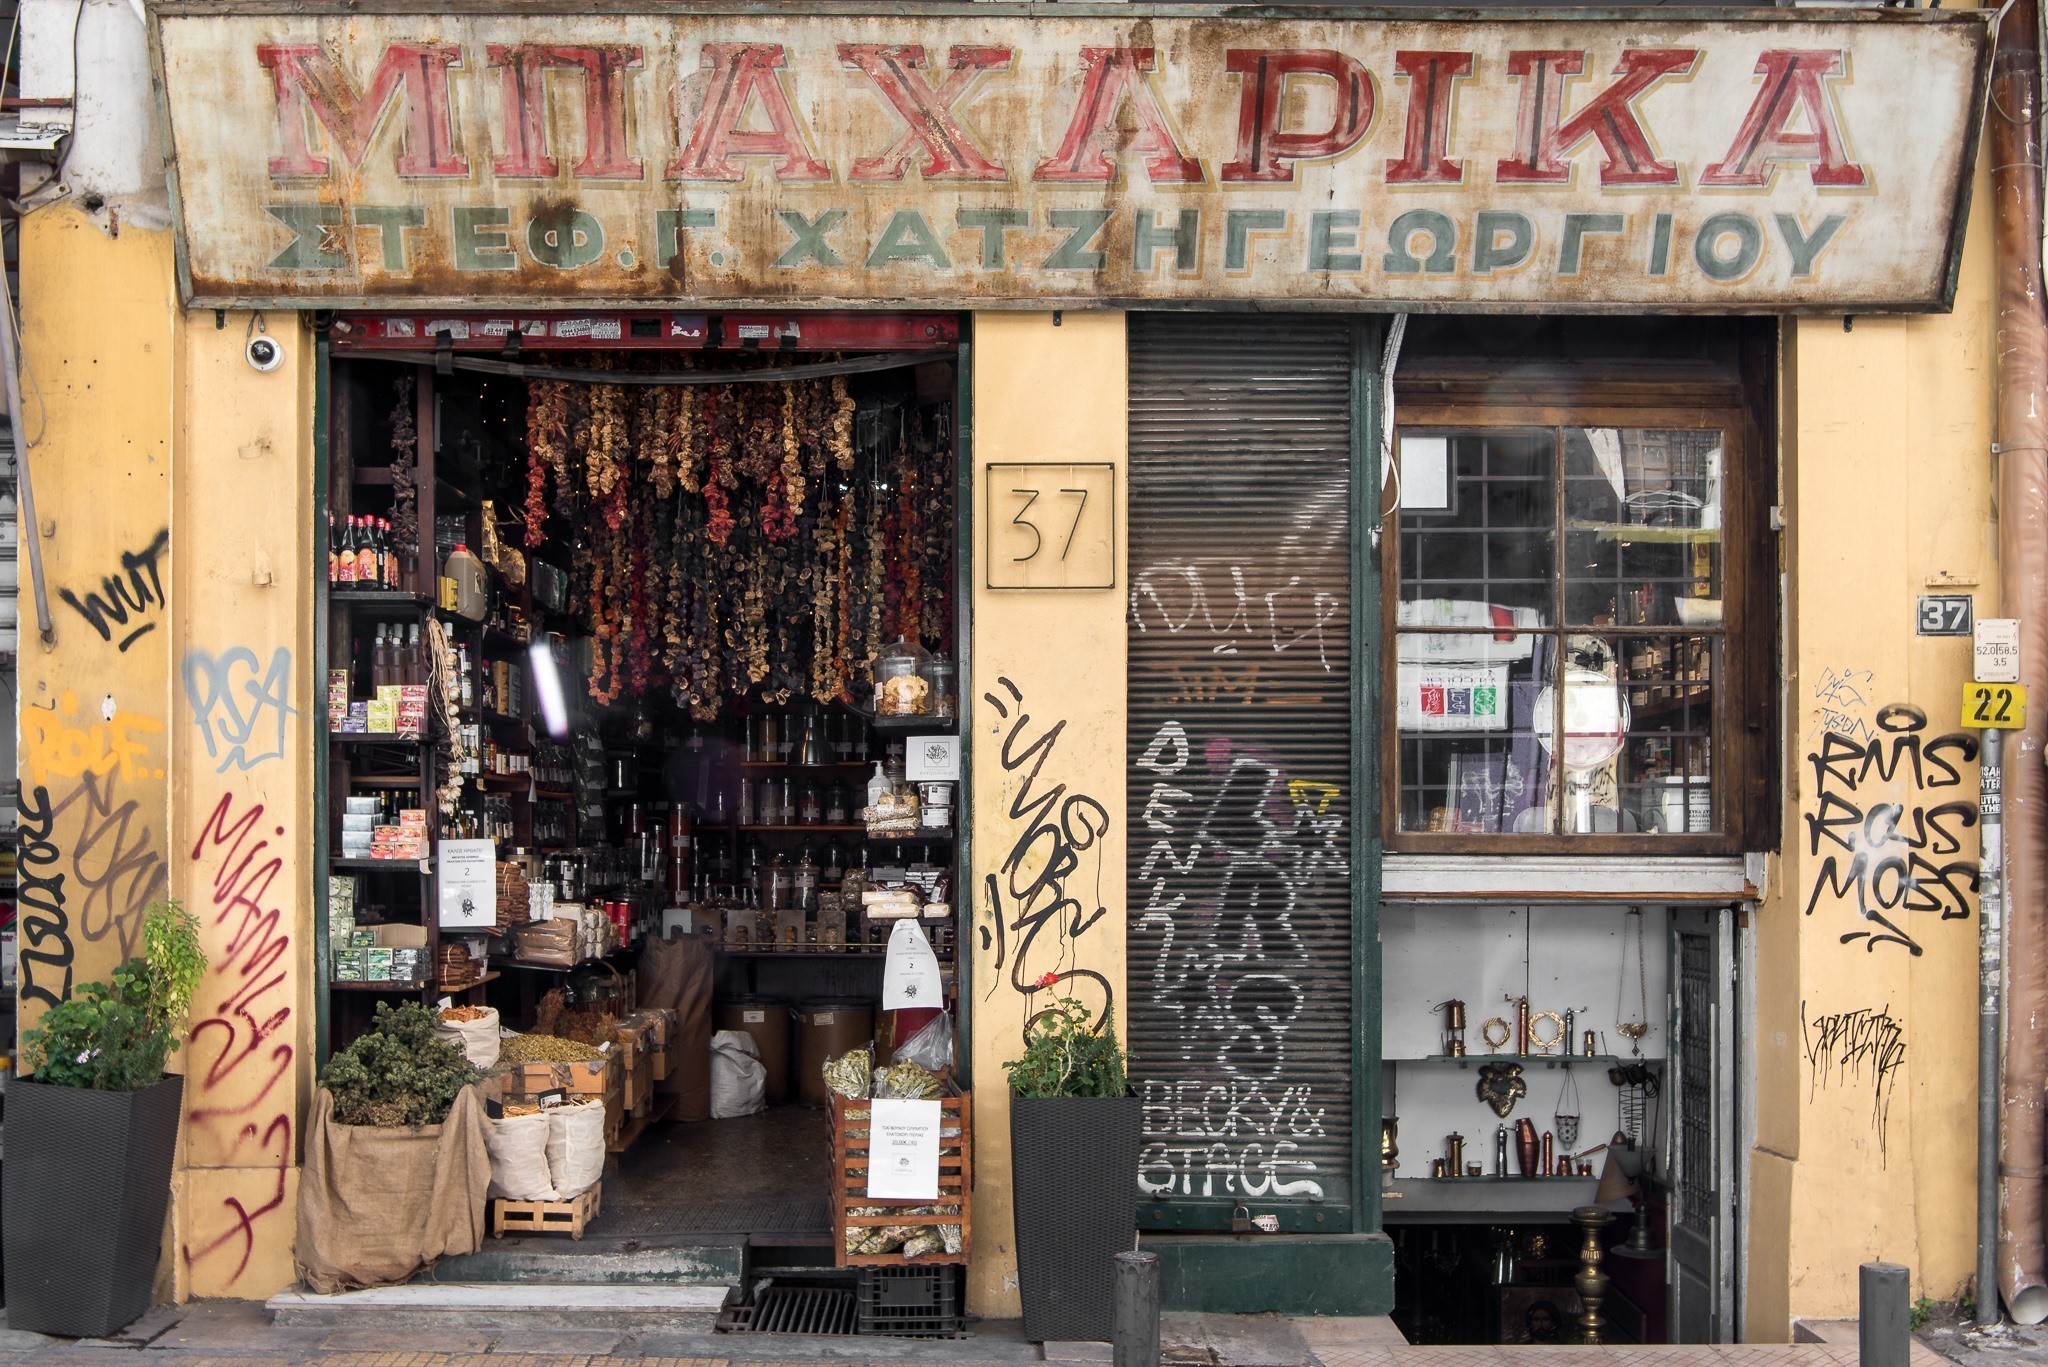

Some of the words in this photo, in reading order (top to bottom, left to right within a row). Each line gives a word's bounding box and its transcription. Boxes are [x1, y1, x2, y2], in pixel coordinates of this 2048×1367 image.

[257, 42, 1869, 187] ΜΠΑΧΑΡΙΚΑ
[266, 204, 637, 274] ΣΤΕΦ.
[655, 208, 728, 271] Γ.
[776, 207, 1848, 282] ΧΑΤΖΗΓΕΩΡΓΙΟΥ
[1011, 487, 1088, 562] 37
[1922, 599, 1968, 633] 37
[1993, 657, 2007, 667] 3.5
[1972, 687, 2013, 723] 22
[464, 867, 470, 876] 2
